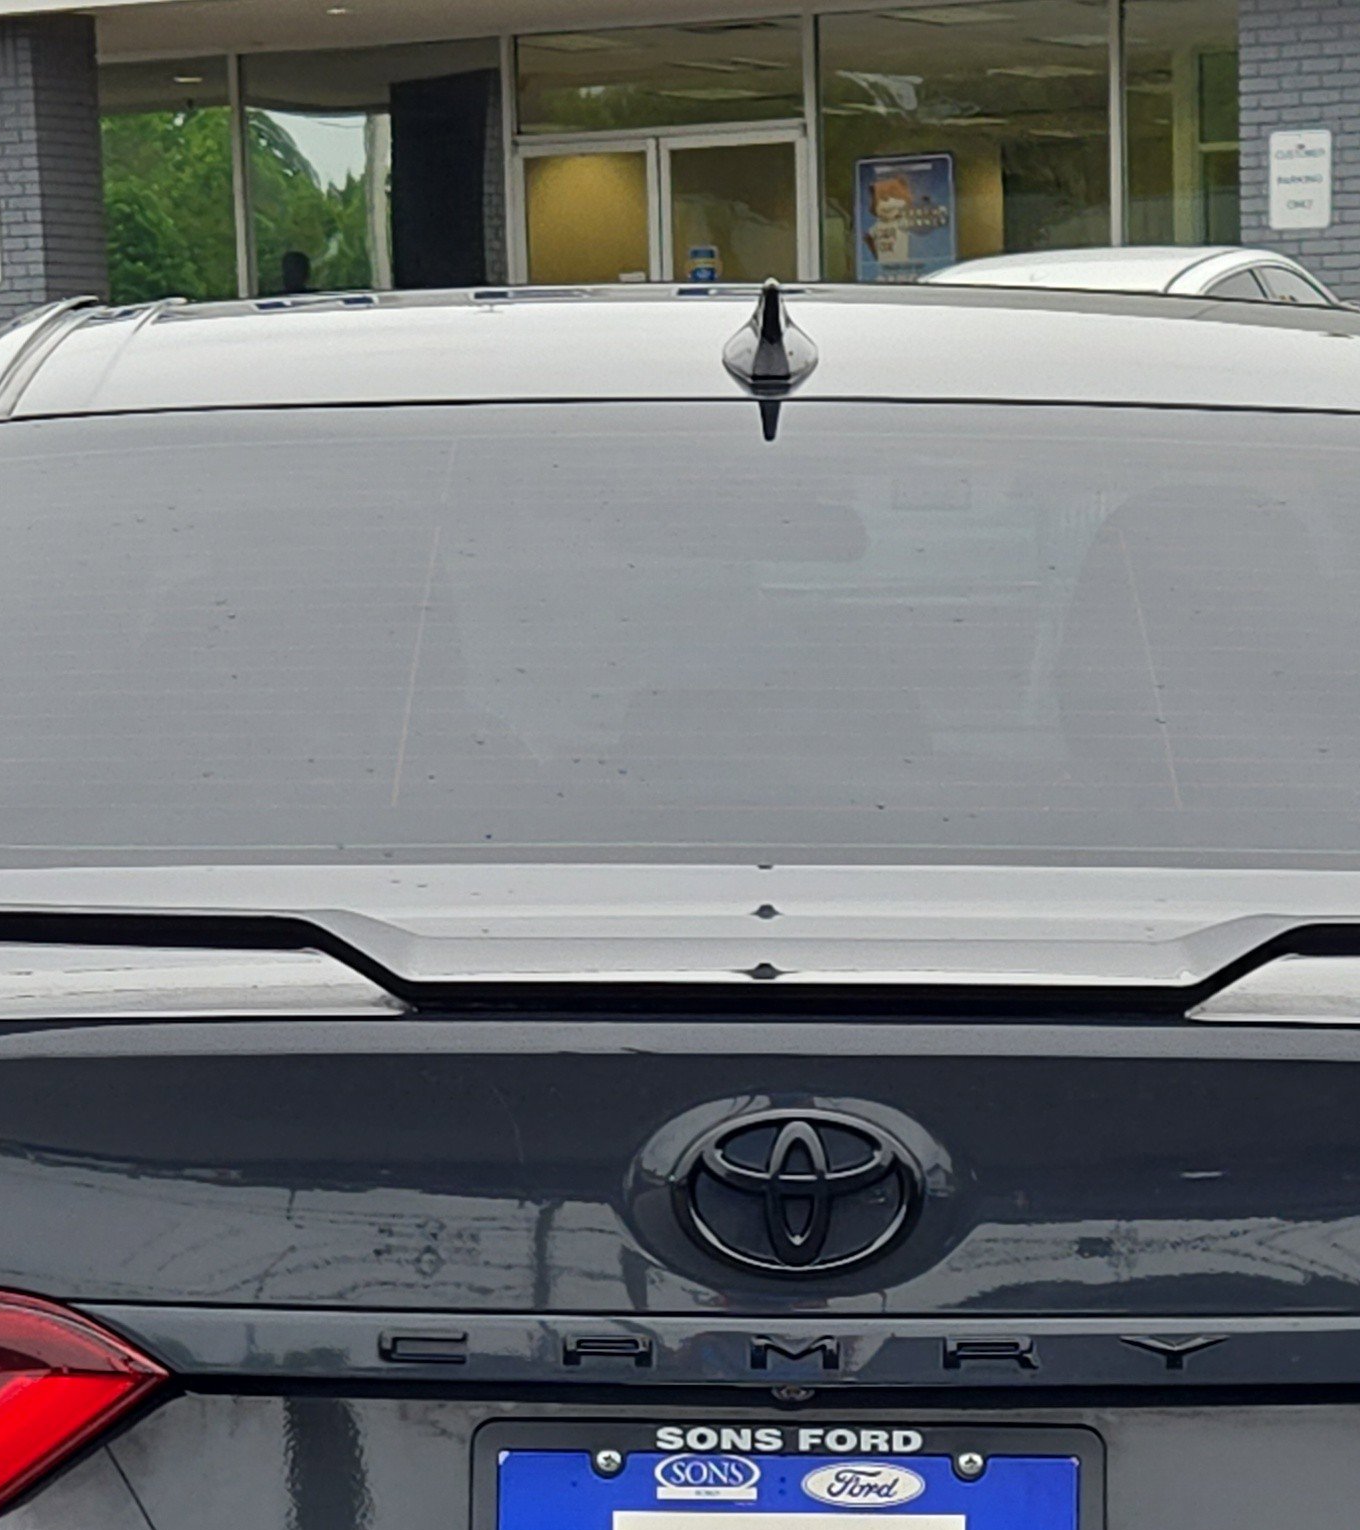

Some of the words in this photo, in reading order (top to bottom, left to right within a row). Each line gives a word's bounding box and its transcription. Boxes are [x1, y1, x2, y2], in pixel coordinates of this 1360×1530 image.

[377, 1330, 1231, 1371] CAMRY
[656, 1427, 783, 1451] SONS
[798, 1428, 923, 1453] FORD
[671, 1460, 743, 1486] SONS
[826, 1469, 899, 1498] Ford
